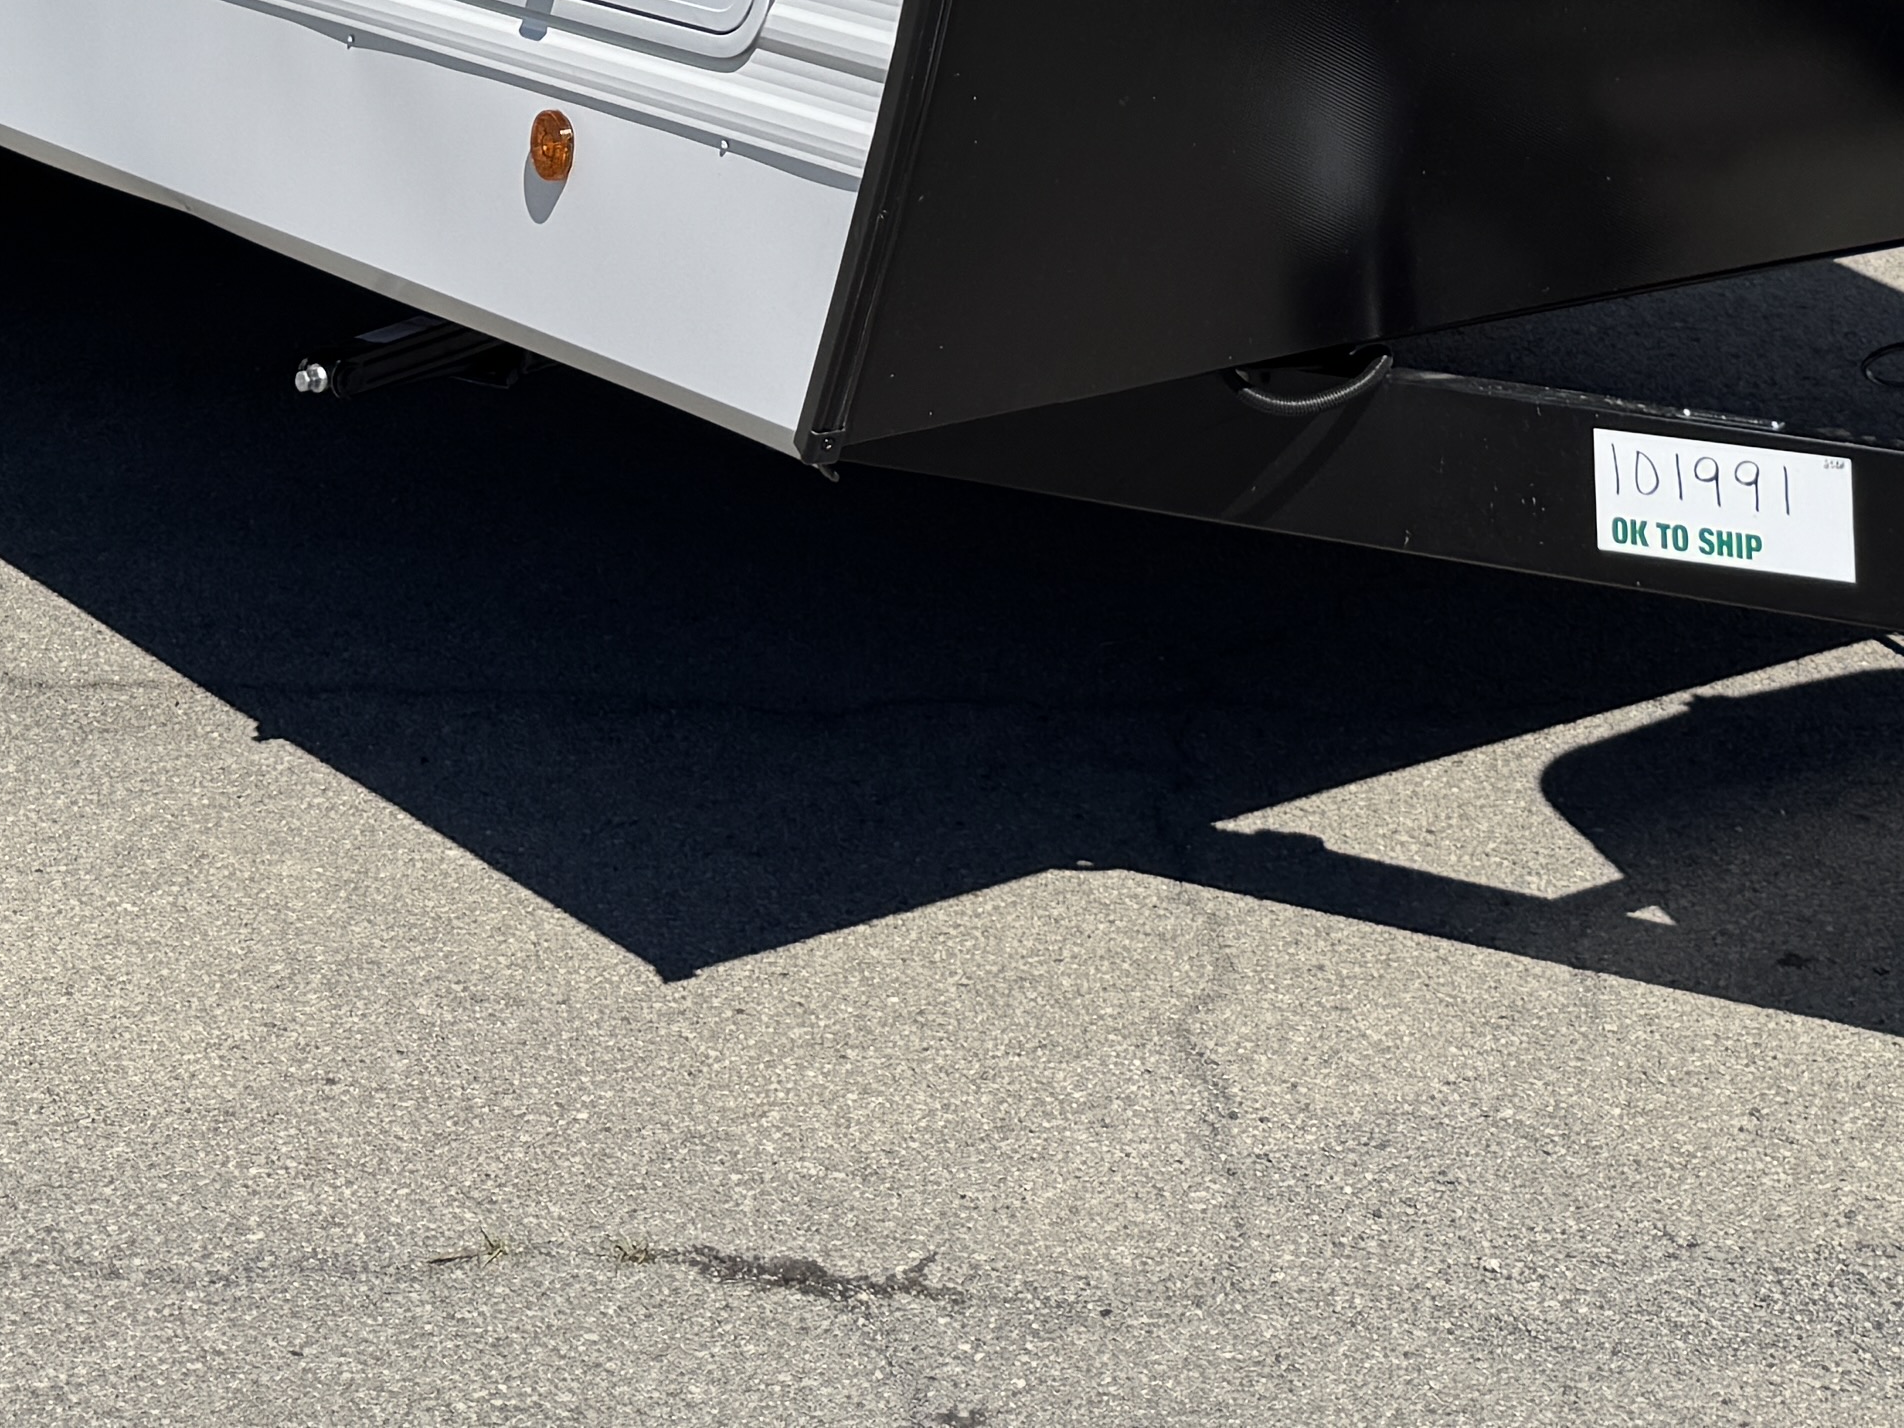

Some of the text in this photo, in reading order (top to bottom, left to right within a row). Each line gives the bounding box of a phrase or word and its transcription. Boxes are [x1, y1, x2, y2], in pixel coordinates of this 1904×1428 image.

[1610, 442, 1791, 516] 101991
[1611, 516, 1763, 560] OK TO SHIP
